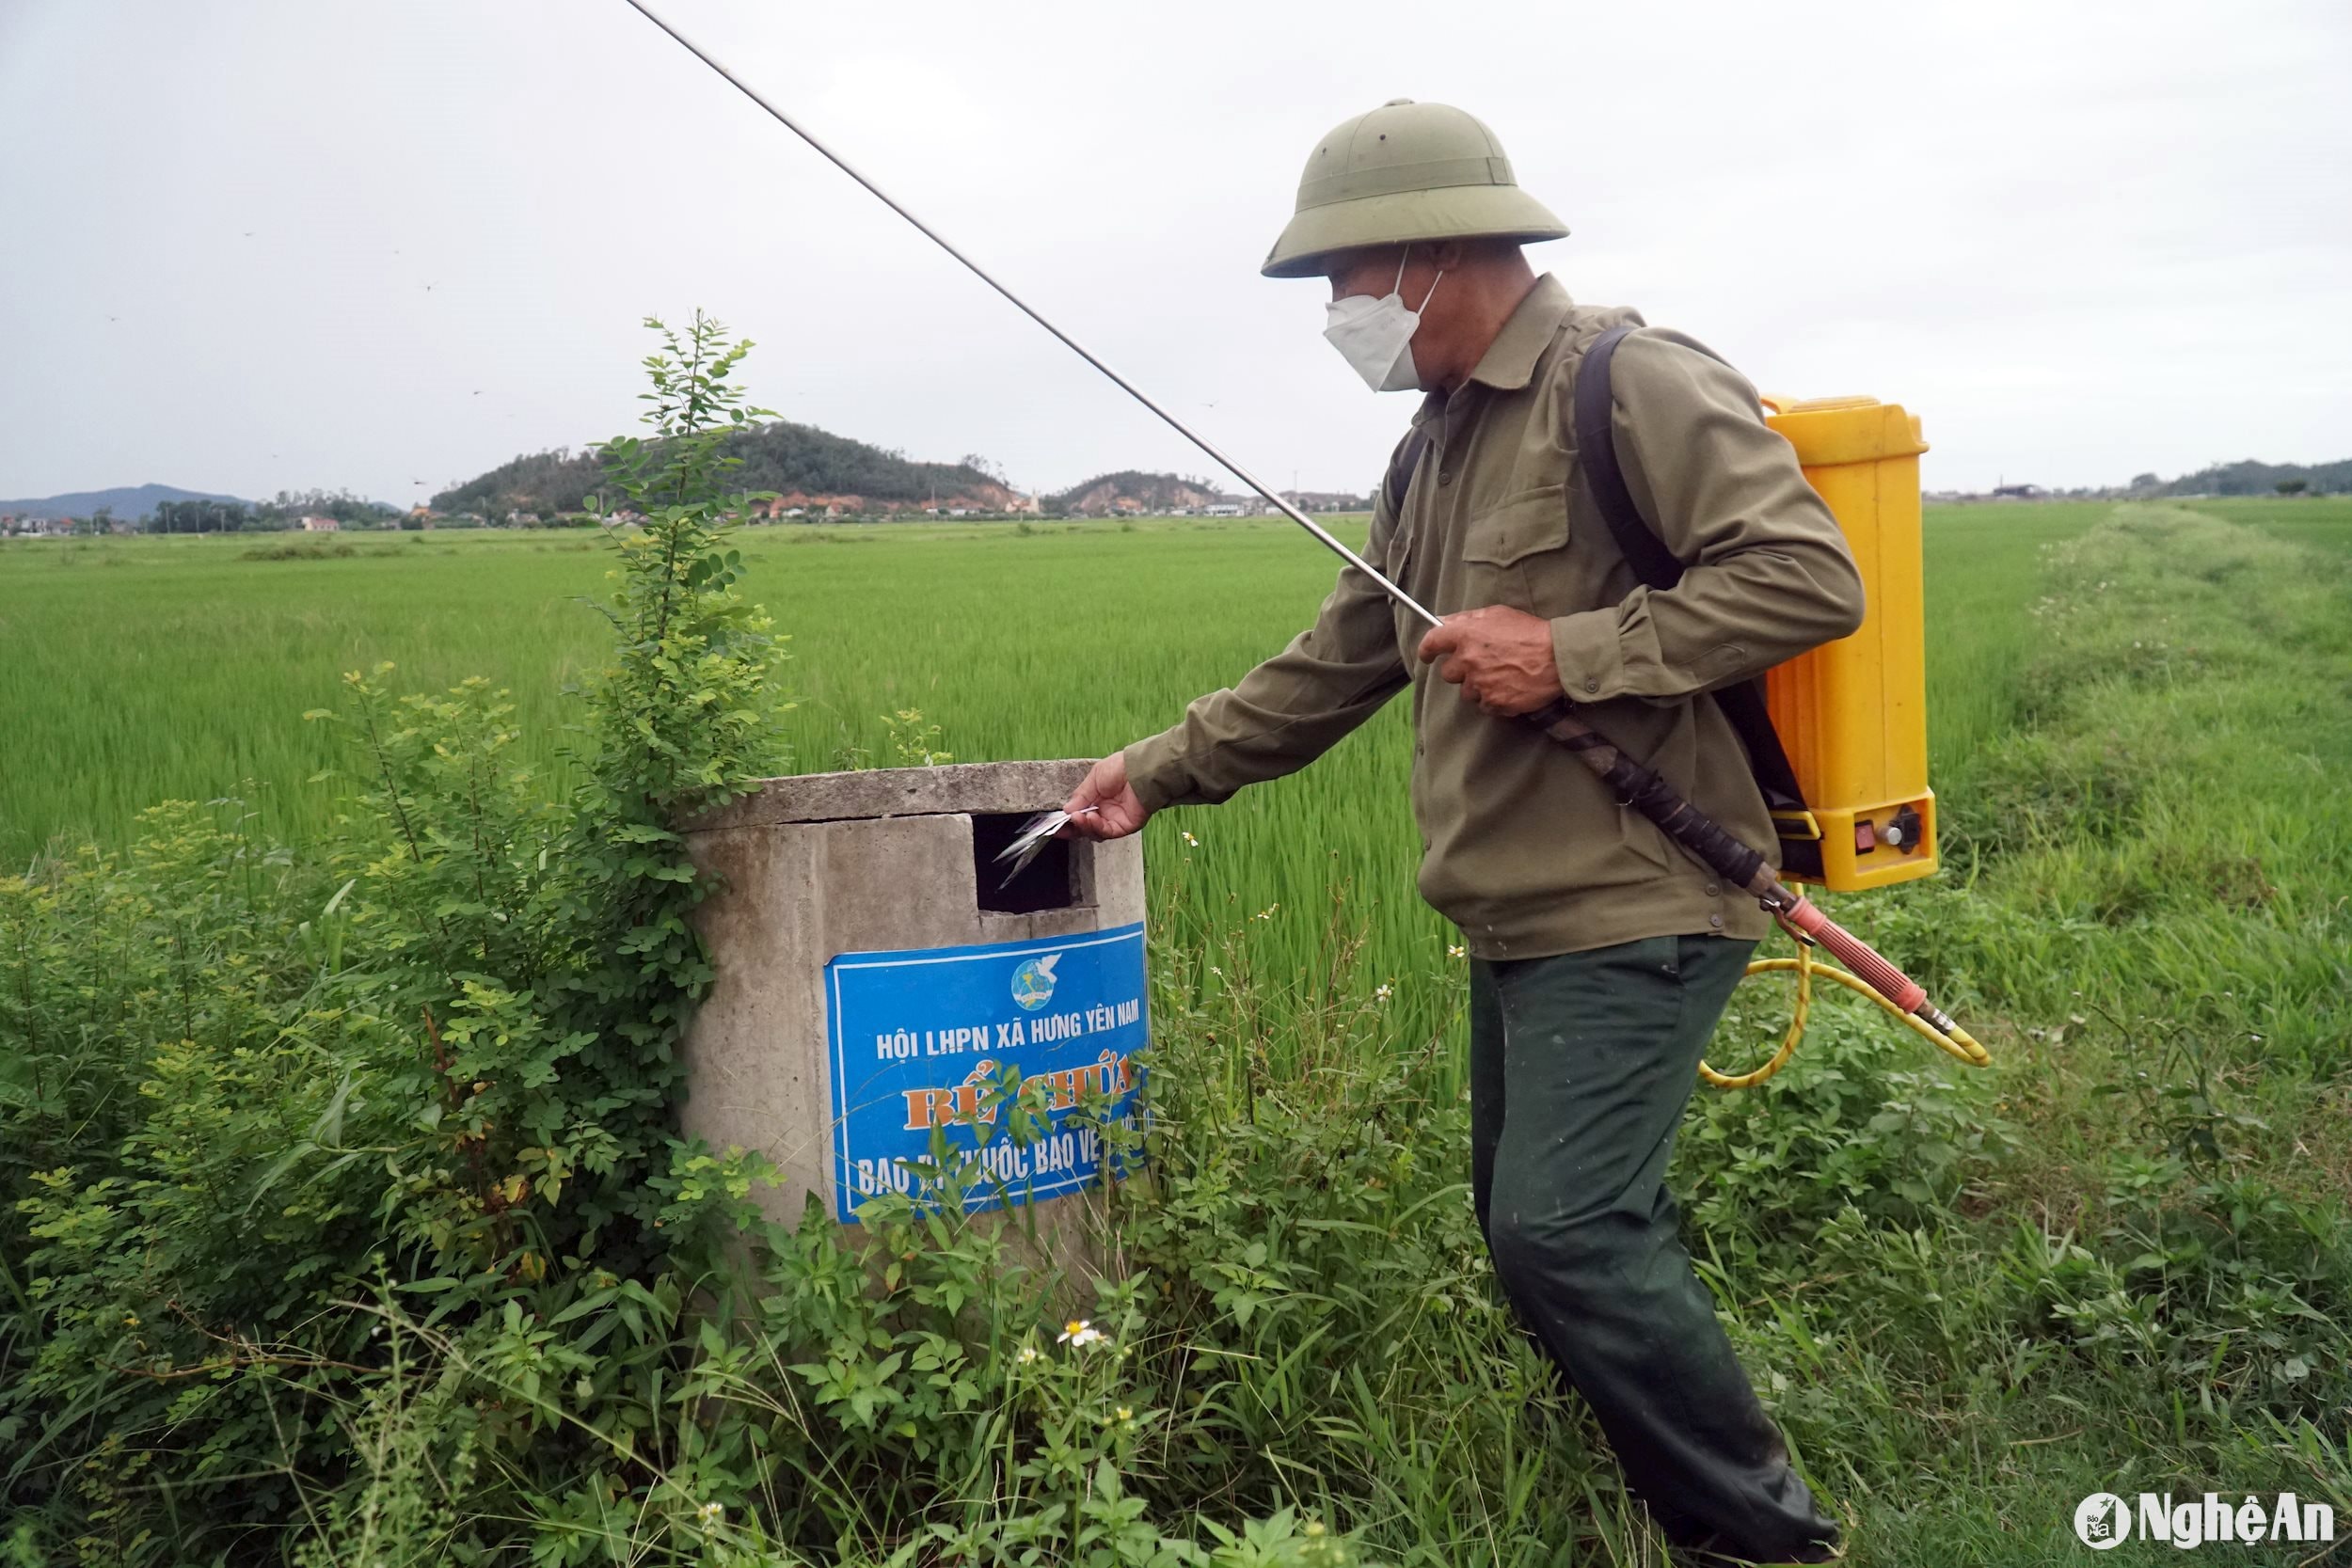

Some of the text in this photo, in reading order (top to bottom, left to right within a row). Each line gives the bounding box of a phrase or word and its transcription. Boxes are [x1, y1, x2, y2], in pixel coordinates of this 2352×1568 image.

[876, 998, 1139, 1065] HỘI LHPN XÃ HƯNG YÊN NAM
[901, 1059, 998, 1131] BỂ
[857, 1156, 911, 1196] BAO
[1034, 1120, 1074, 1176] BẢO
